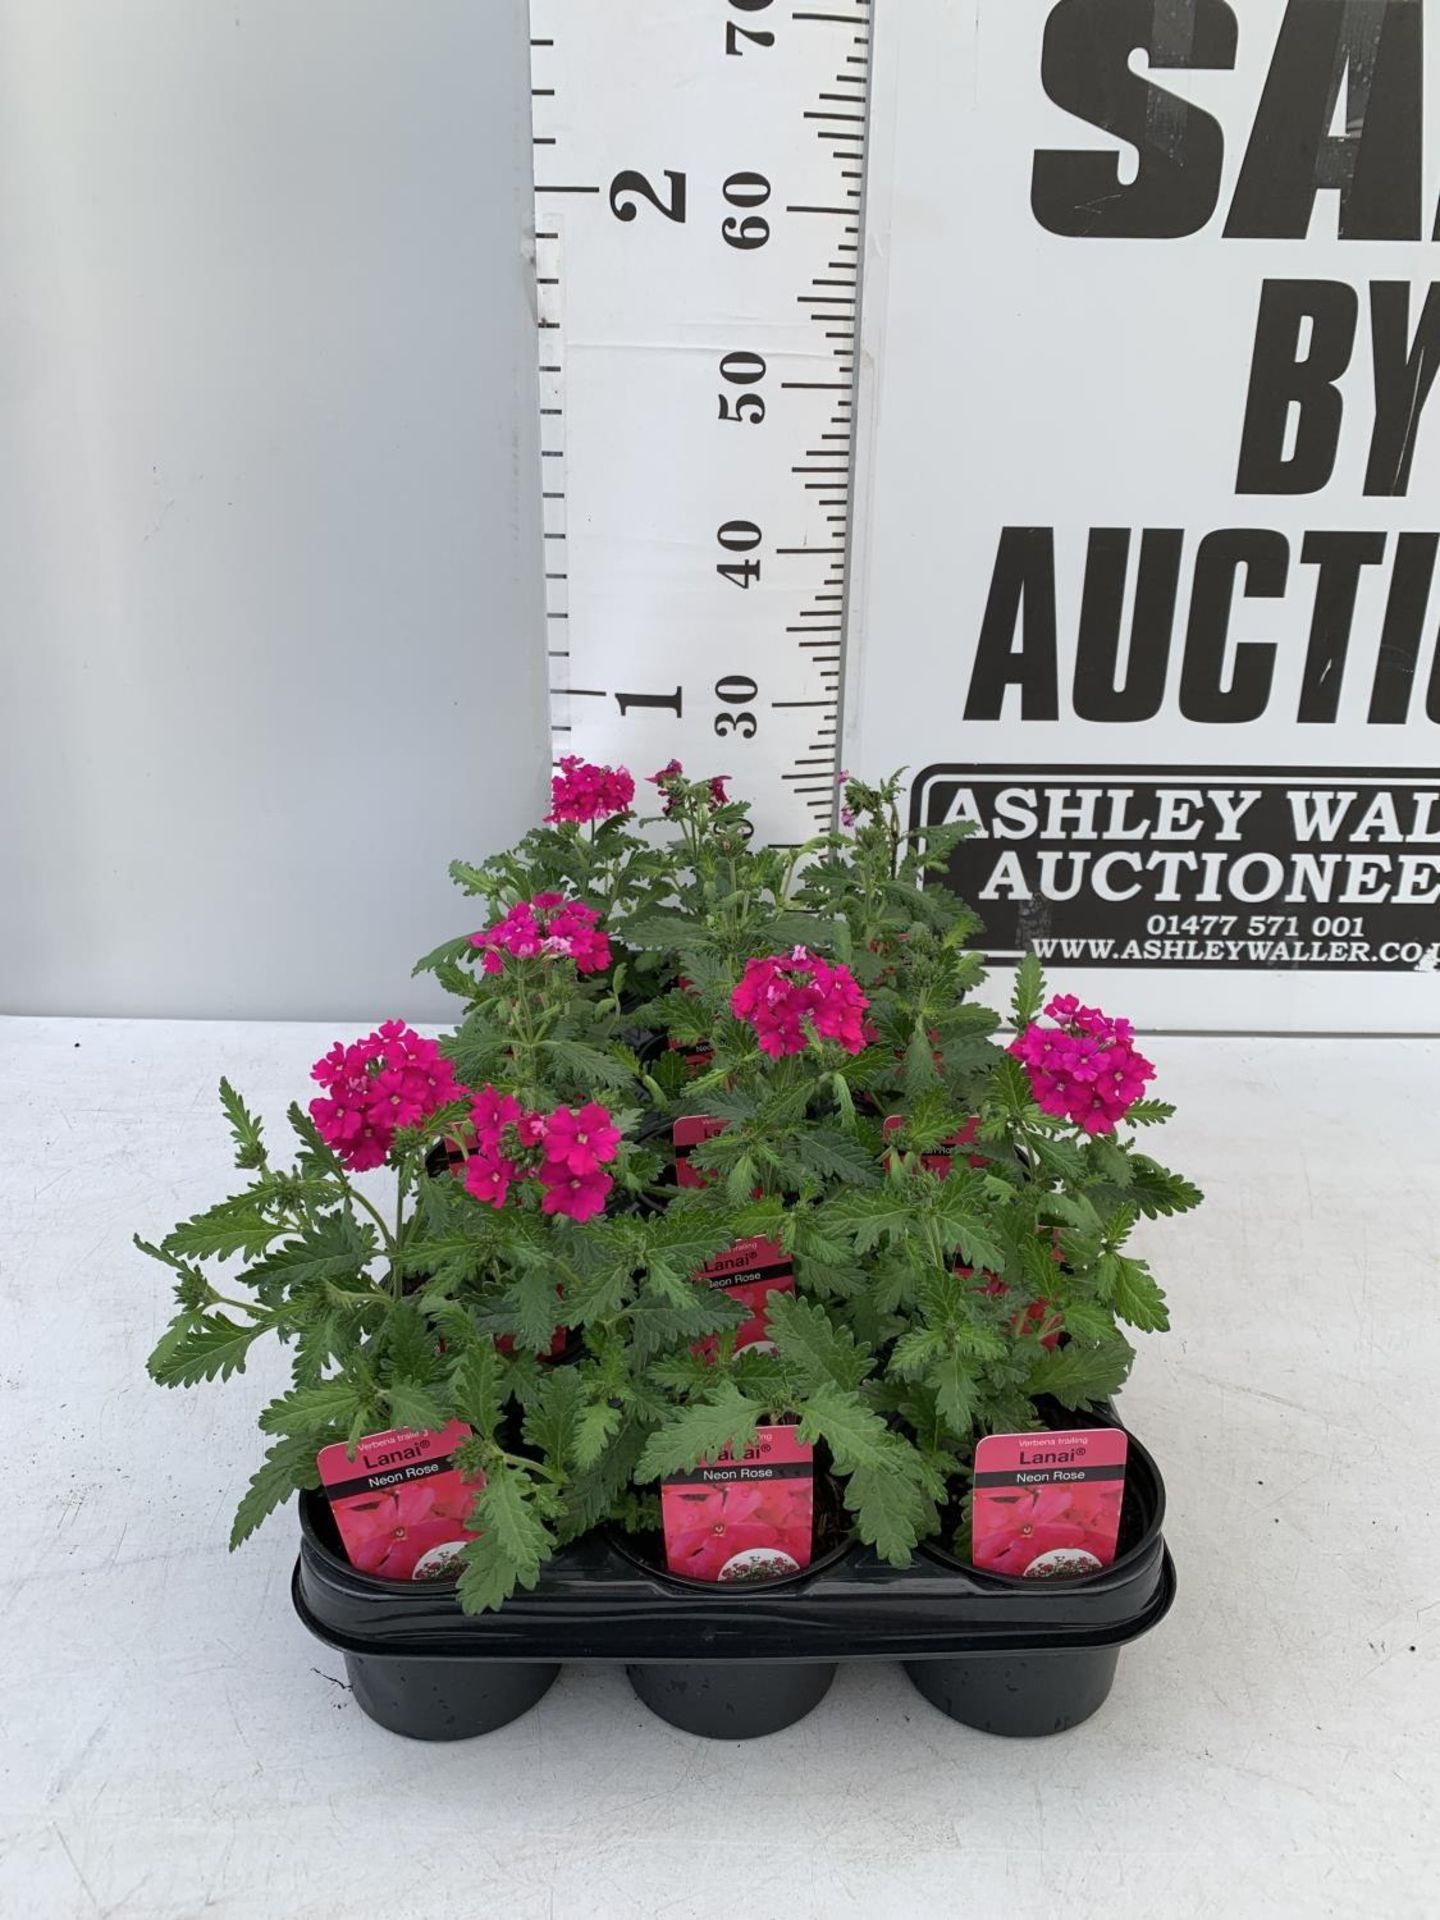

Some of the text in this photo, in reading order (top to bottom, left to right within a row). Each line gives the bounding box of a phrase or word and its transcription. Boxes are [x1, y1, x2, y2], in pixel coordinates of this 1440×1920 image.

[1030, 0, 1440, 241] SA
[609, 169, 687, 224] 2
[721, 171, 772, 250] 60
[718, 351, 767, 424] 50
[1234, 278, 1440, 497] BY
[716, 520, 763, 590] 40
[962, 526, 1440, 725] AUCTI
[614, 685, 683, 719] 1
[714, 675, 759, 739] 30
[941, 788, 1262, 841] ASHLEY
[1146, 915, 1365, 937] 01477 571 001
[734, 1272, 761, 1284] Rose
[1018, 1436, 1089, 1447] Verbena trailing
[368, 1463, 440, 1488] Neon Rose
[703, 1467, 774, 1481] Neon Rose
[1016, 1470, 1086, 1483] Neon Rose
